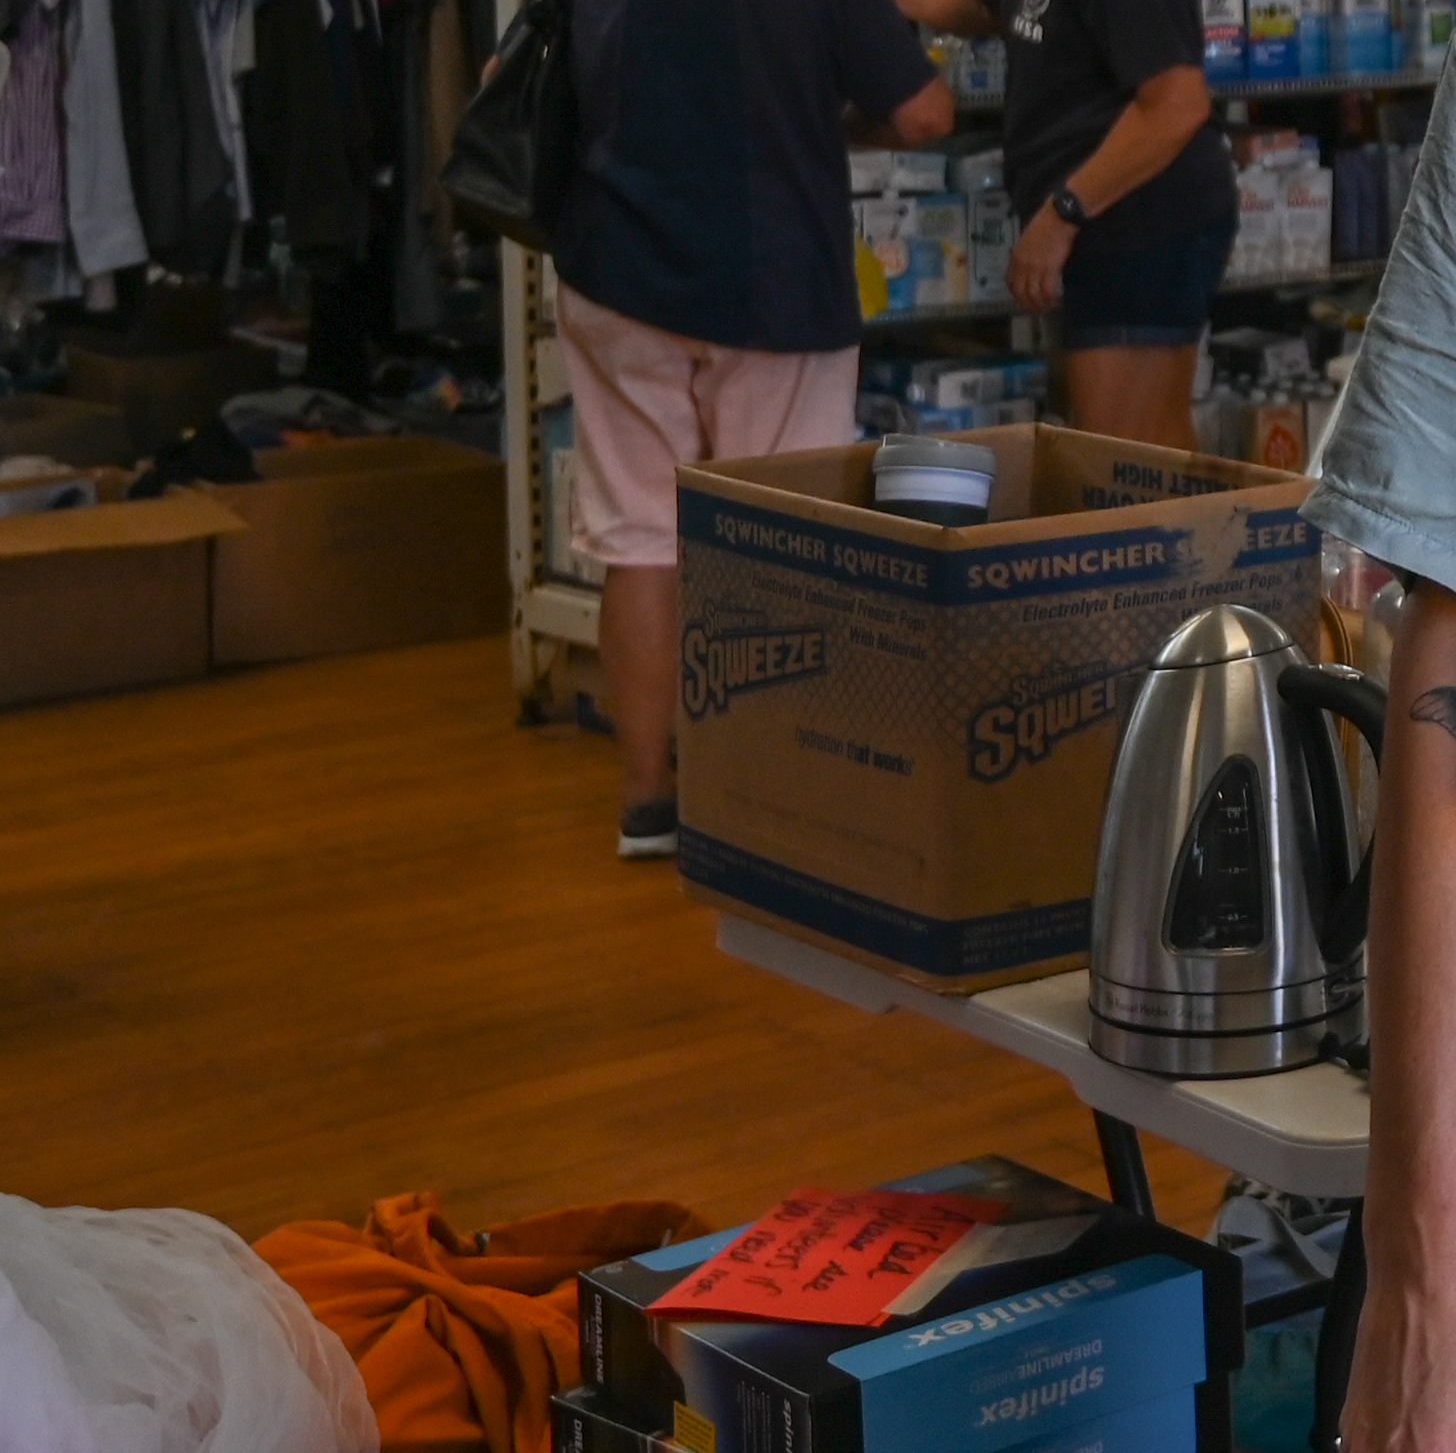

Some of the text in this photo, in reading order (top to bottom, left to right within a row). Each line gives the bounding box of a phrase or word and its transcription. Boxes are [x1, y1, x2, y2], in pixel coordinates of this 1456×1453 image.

[1112, 461, 1164, 493] HIGH
[714, 513, 928, 589] SQWINCHER SQWEEZE
[967, 540, 1166, 589] SQWINCHER
[854, 594, 897, 623] Freezer
[900, 607, 927, 634] Pops
[1022, 573, 1284, 623] Electrolyte Enhanced Freezer Pops
[685, 627, 823, 714] SQWEEZE
[877, 632, 928, 662] Minerals
[908, 1273, 1117, 1348] spinifex
[594, 1293, 604, 1384] DREAMLINE
[1017, 1338, 1103, 1377] DREAMLINE
[978, 1366, 1105, 1428] spinifex
